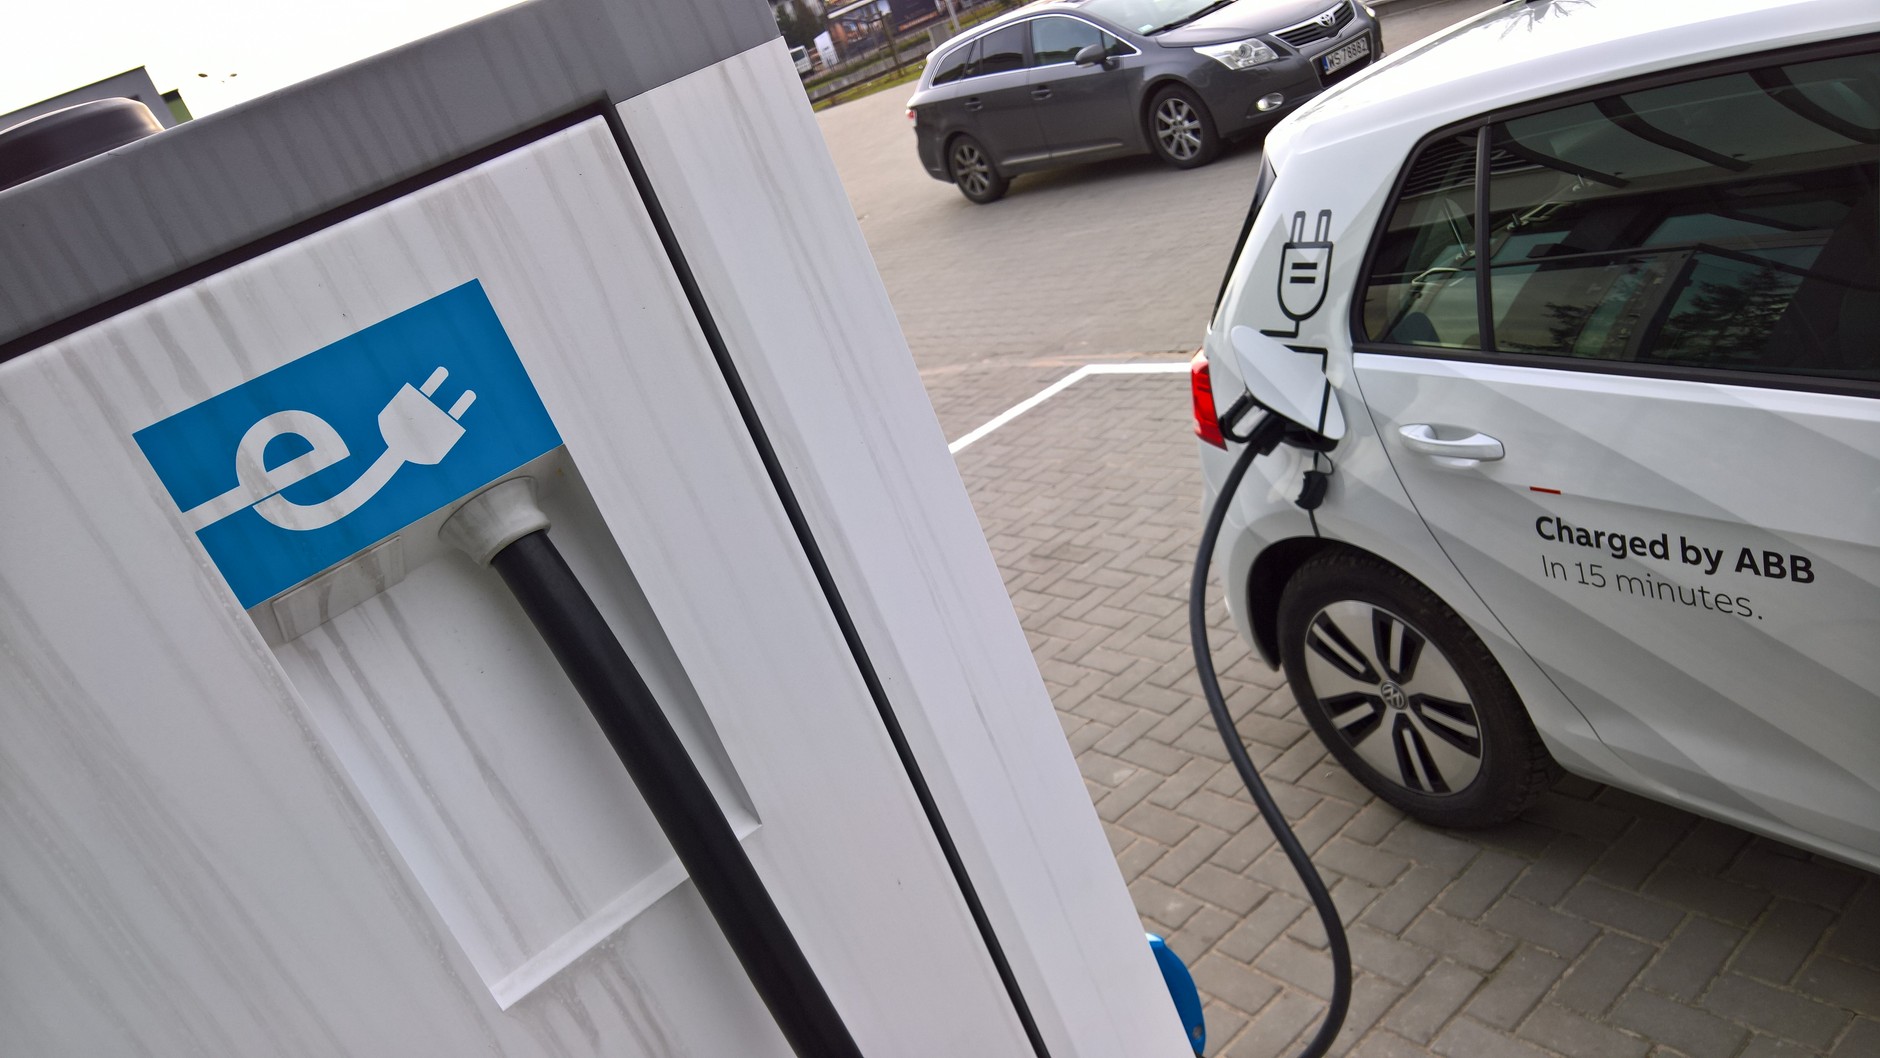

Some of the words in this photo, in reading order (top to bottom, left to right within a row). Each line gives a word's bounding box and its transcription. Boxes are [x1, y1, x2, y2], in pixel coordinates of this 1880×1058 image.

[1535, 515, 1670, 560] Charged
[1679, 535, 1724, 576] by
[1734, 546, 1815, 585] ABB
[1541, 554, 1568, 582] In
[1574, 561, 1607, 589] 15
[1615, 573, 1763, 621] minutes.
